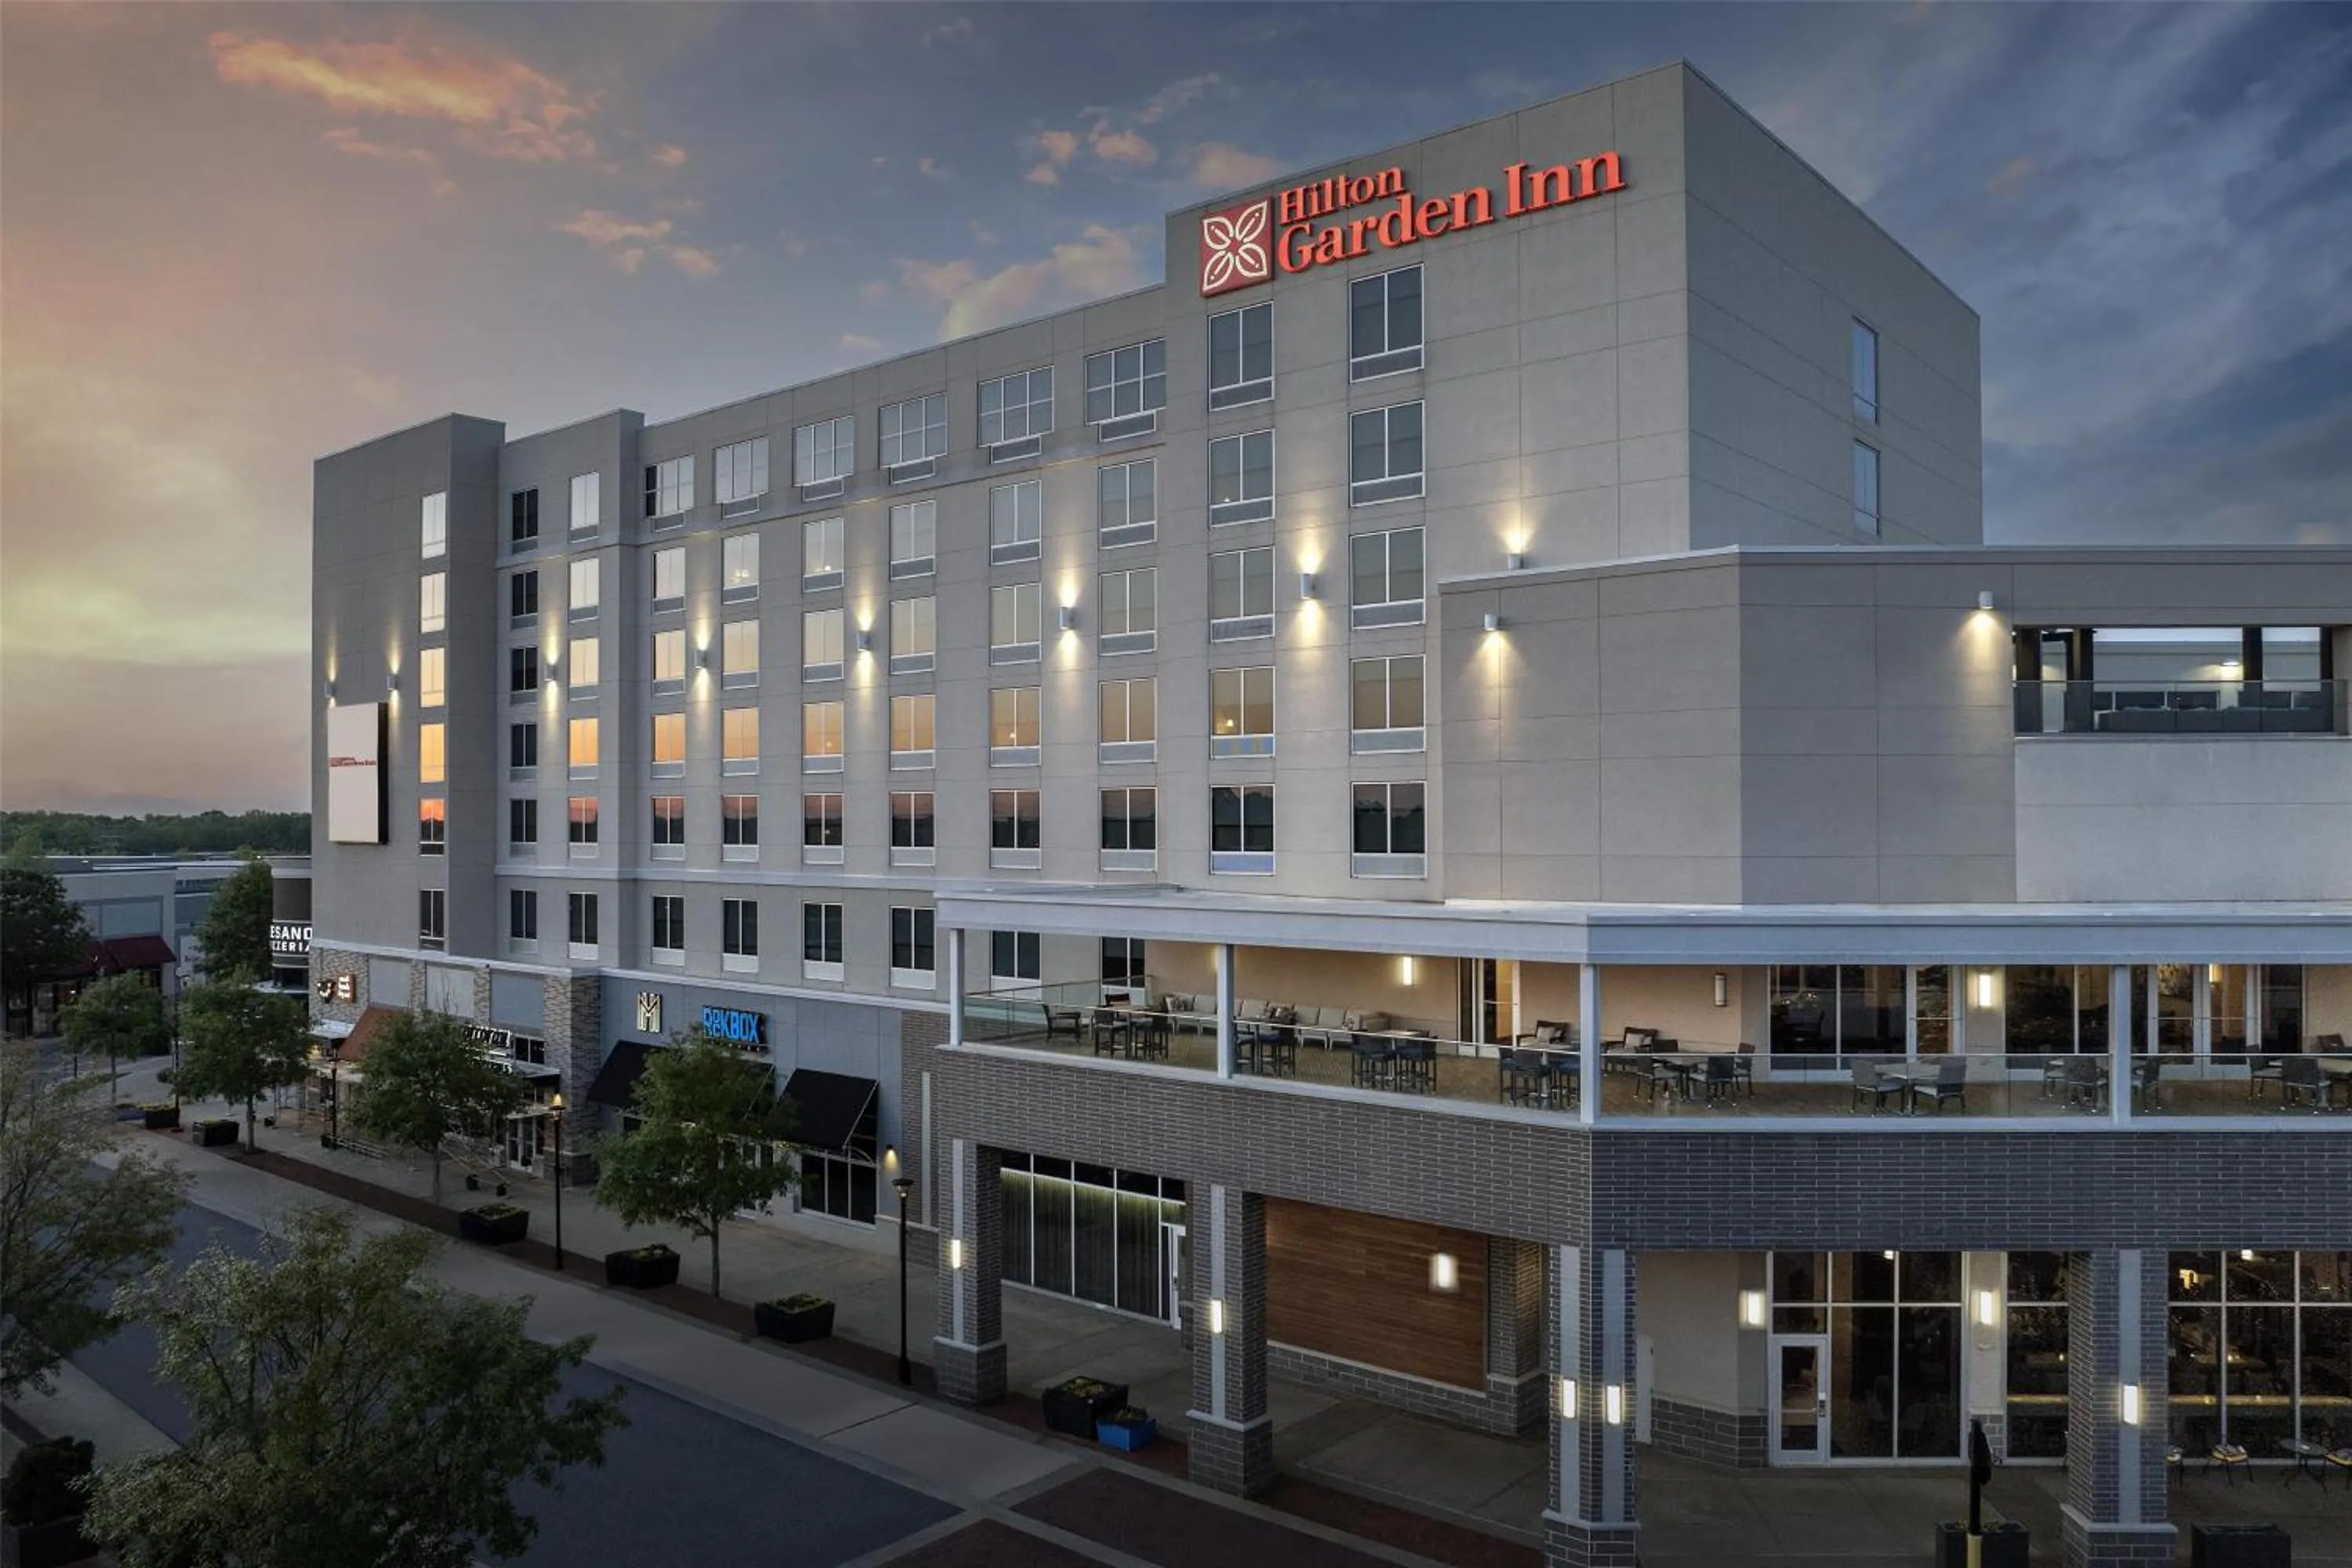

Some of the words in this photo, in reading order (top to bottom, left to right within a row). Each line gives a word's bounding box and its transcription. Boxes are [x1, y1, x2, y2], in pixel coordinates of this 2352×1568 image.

[1279, 166, 1404, 224] Hilton
[1279, 185, 1493, 272] Garden
[1504, 150, 1625, 216] Inn
